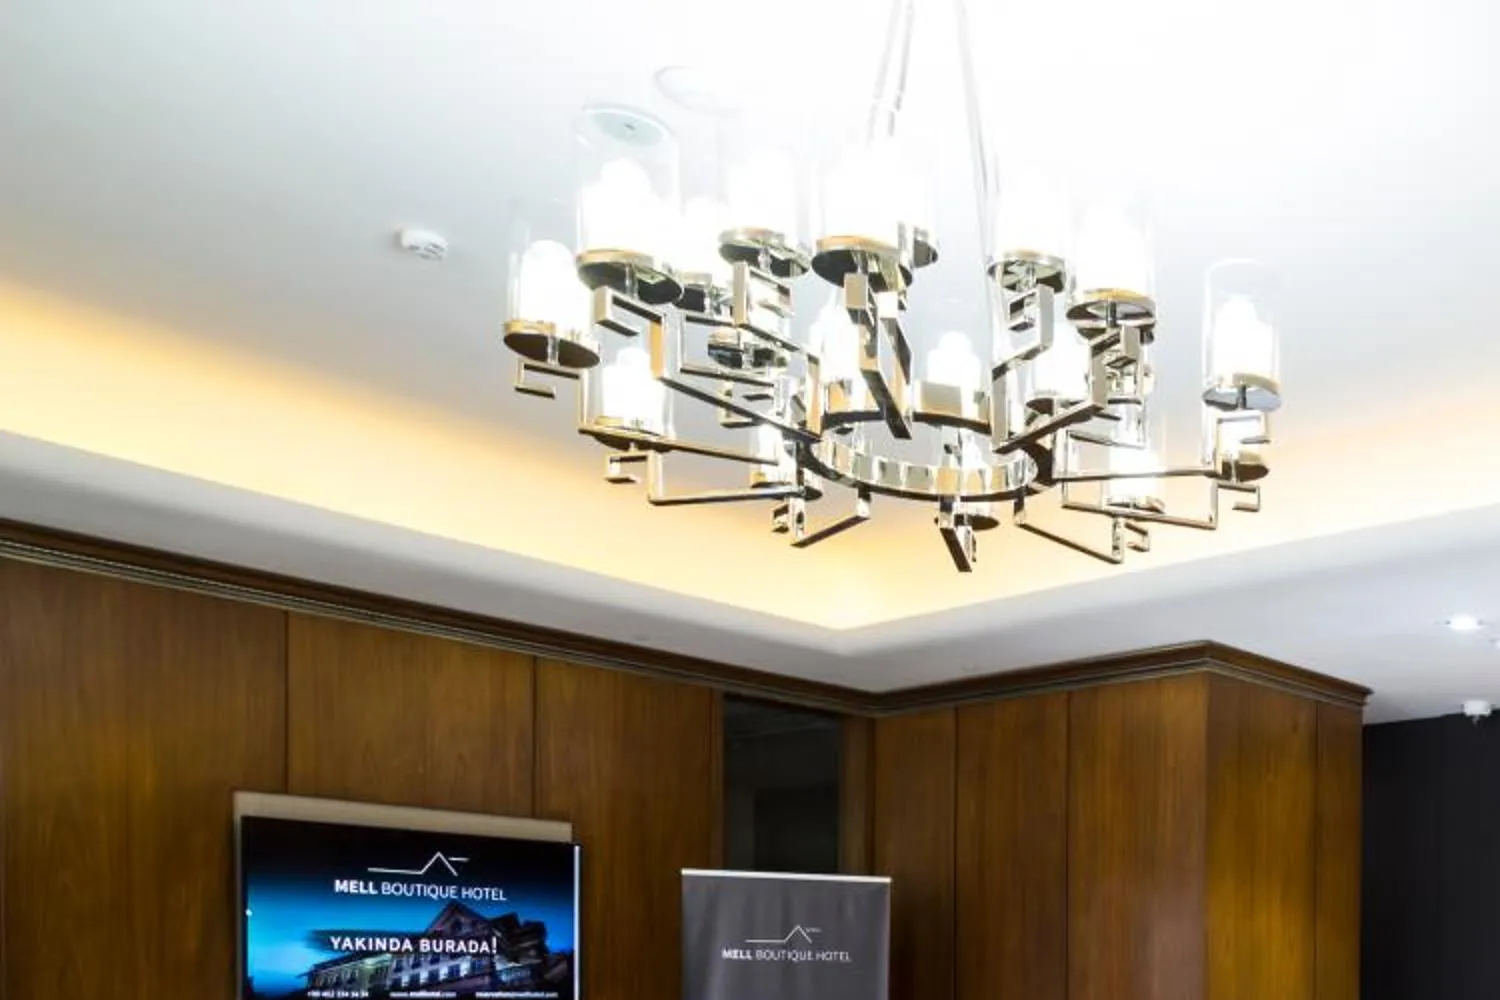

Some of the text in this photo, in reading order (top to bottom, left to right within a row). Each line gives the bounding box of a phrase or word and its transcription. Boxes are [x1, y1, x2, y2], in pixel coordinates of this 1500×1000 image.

[334, 879, 507, 901] MELL BOUTIQUE HOTEL
[329, 936, 498, 954] YAKINDA BURADA!
[722, 949, 851, 963] MELL BOUTIQUE HOTEL
